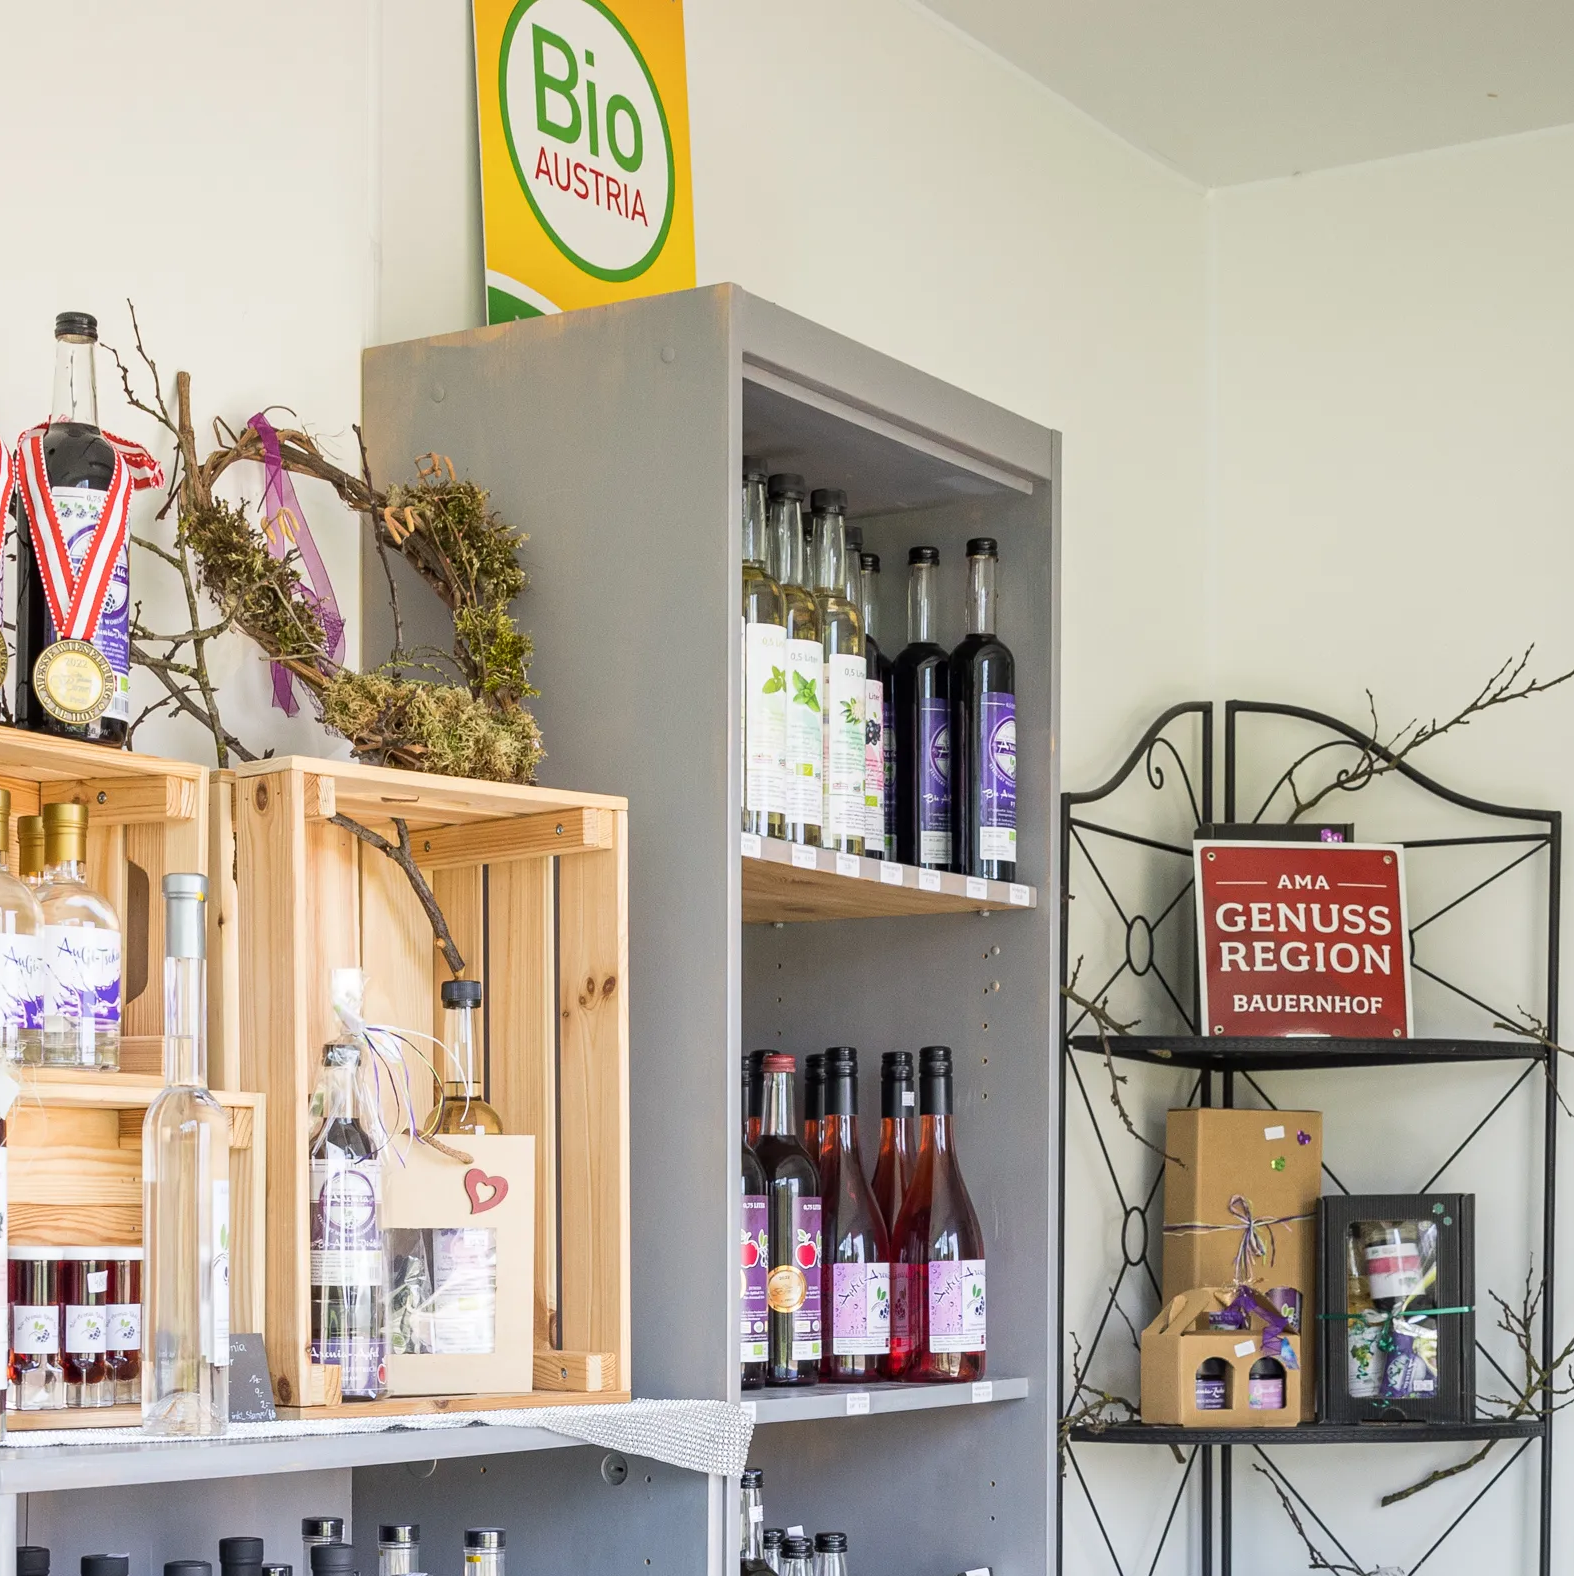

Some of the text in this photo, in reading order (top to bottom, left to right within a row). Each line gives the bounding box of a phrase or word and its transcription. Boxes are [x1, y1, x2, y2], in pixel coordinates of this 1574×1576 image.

[532, 23, 643, 173] Bio
[535, 147, 648, 226] AUSTRIA
[791, 652, 803, 662] 0,5
[37, 650, 56, 691] MESSE
[56, 642, 112, 700] WIESELBURG
[844, 668, 855, 676] 0,5
[72, 710, 95, 722] HOF
[1278, 875, 1330, 890] AMA
[1216, 903, 1391, 935] GENUSS
[1219, 942, 1390, 975] REGION
[1233, 995, 1382, 1014] BAUERNHOF
